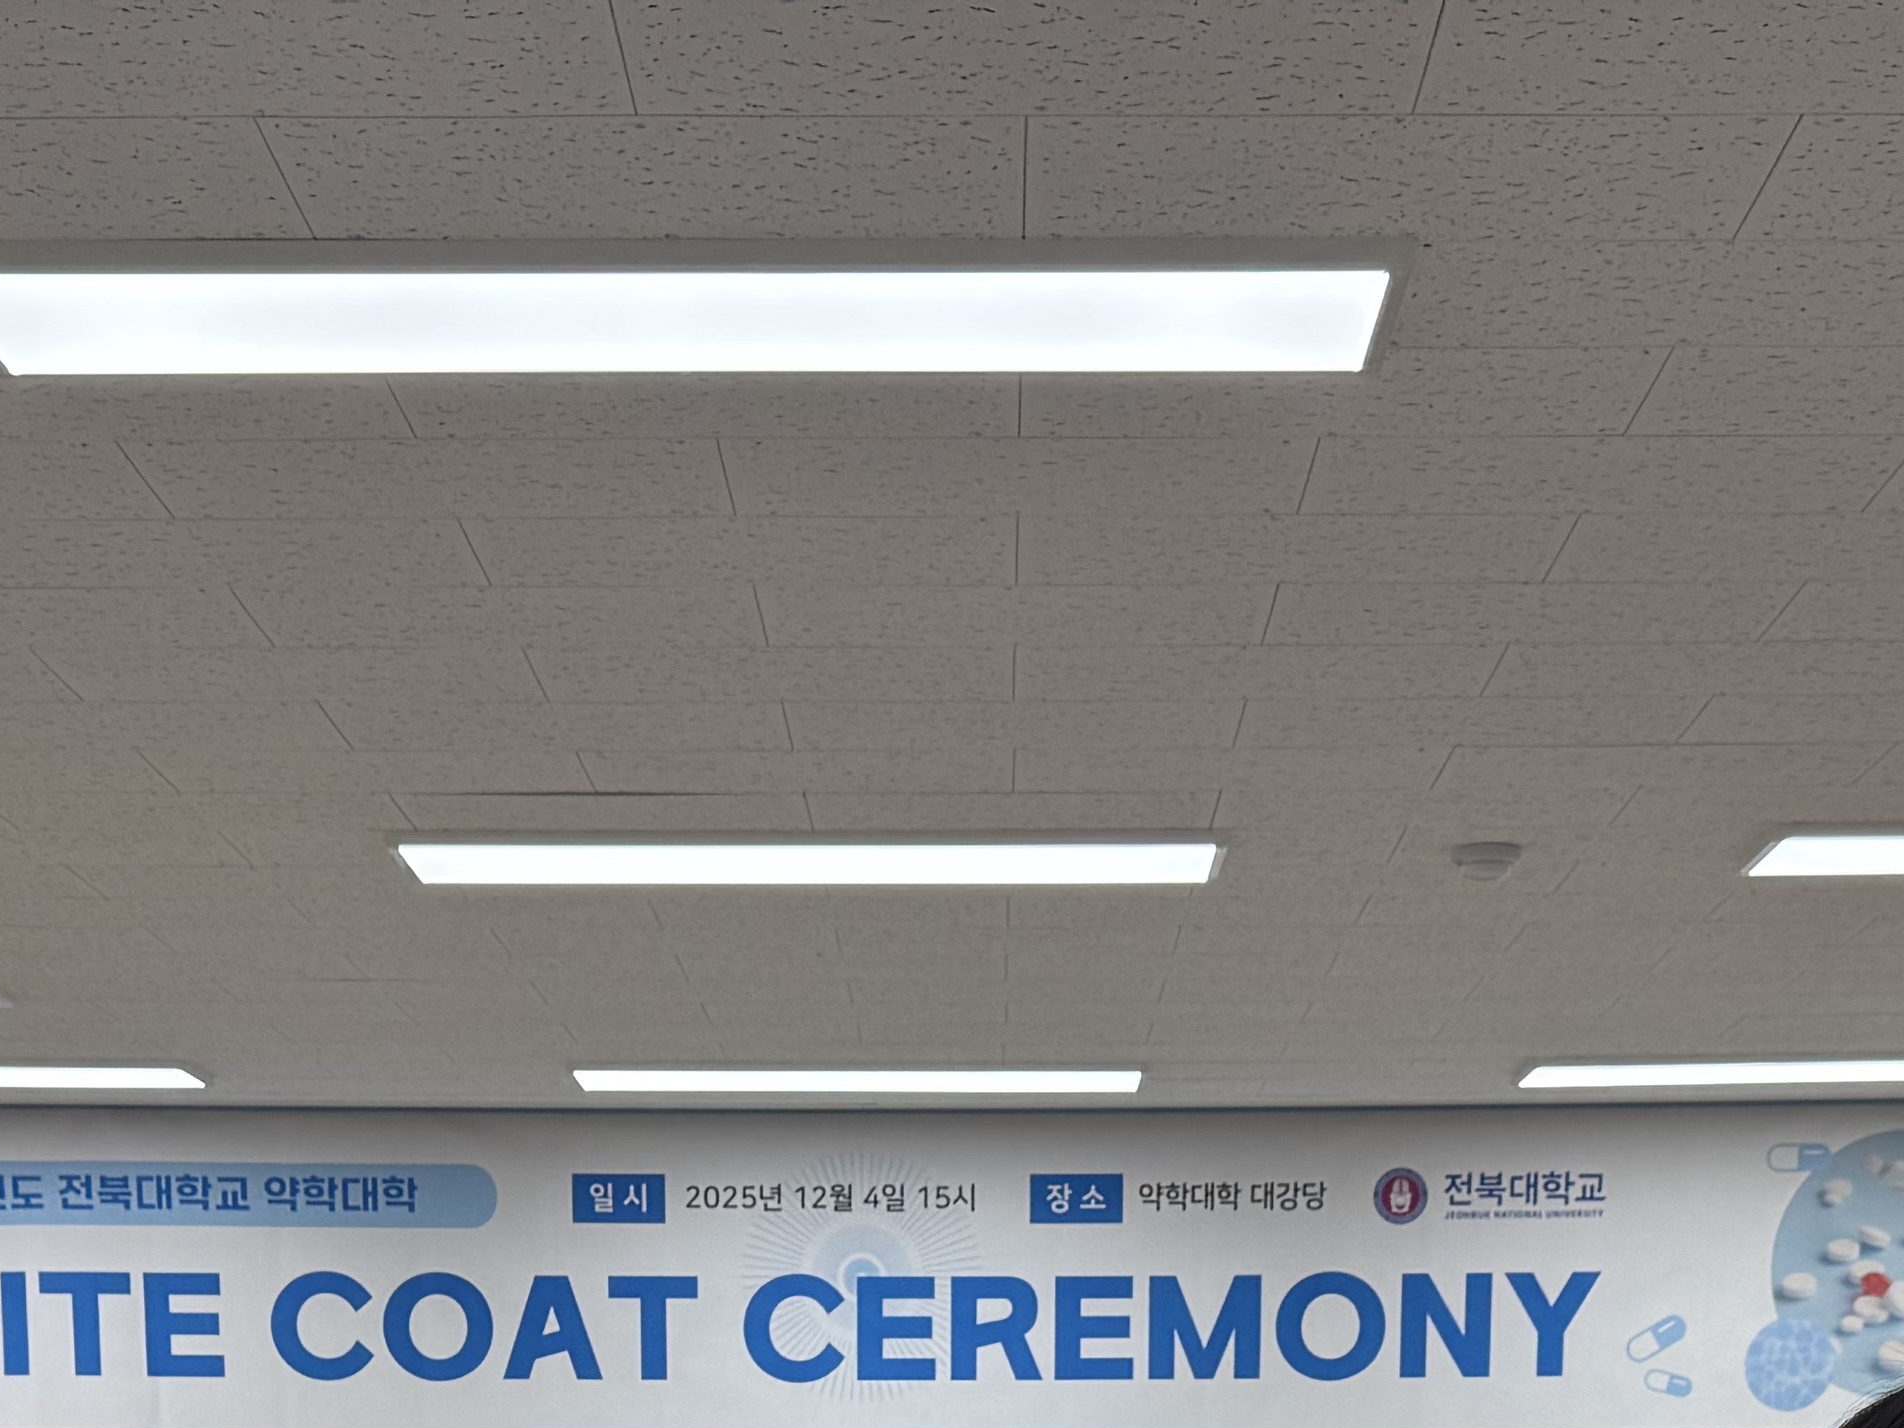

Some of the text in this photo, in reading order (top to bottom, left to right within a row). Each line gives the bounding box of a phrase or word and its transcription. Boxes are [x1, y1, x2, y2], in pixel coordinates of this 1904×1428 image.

[58, 1173, 250, 1212] 전북대학교
[264, 1175, 418, 1213] 약학대학
[685, 1183, 975, 1213] 2025년 12월 4일 15시
[1139, 1181, 1327, 1212] 약학대학 대강당
[1444, 1171, 1606, 1206] 전북대학교
[270, 1270, 698, 1382] COAT
[743, 1270, 1602, 1383] CEREMONY
